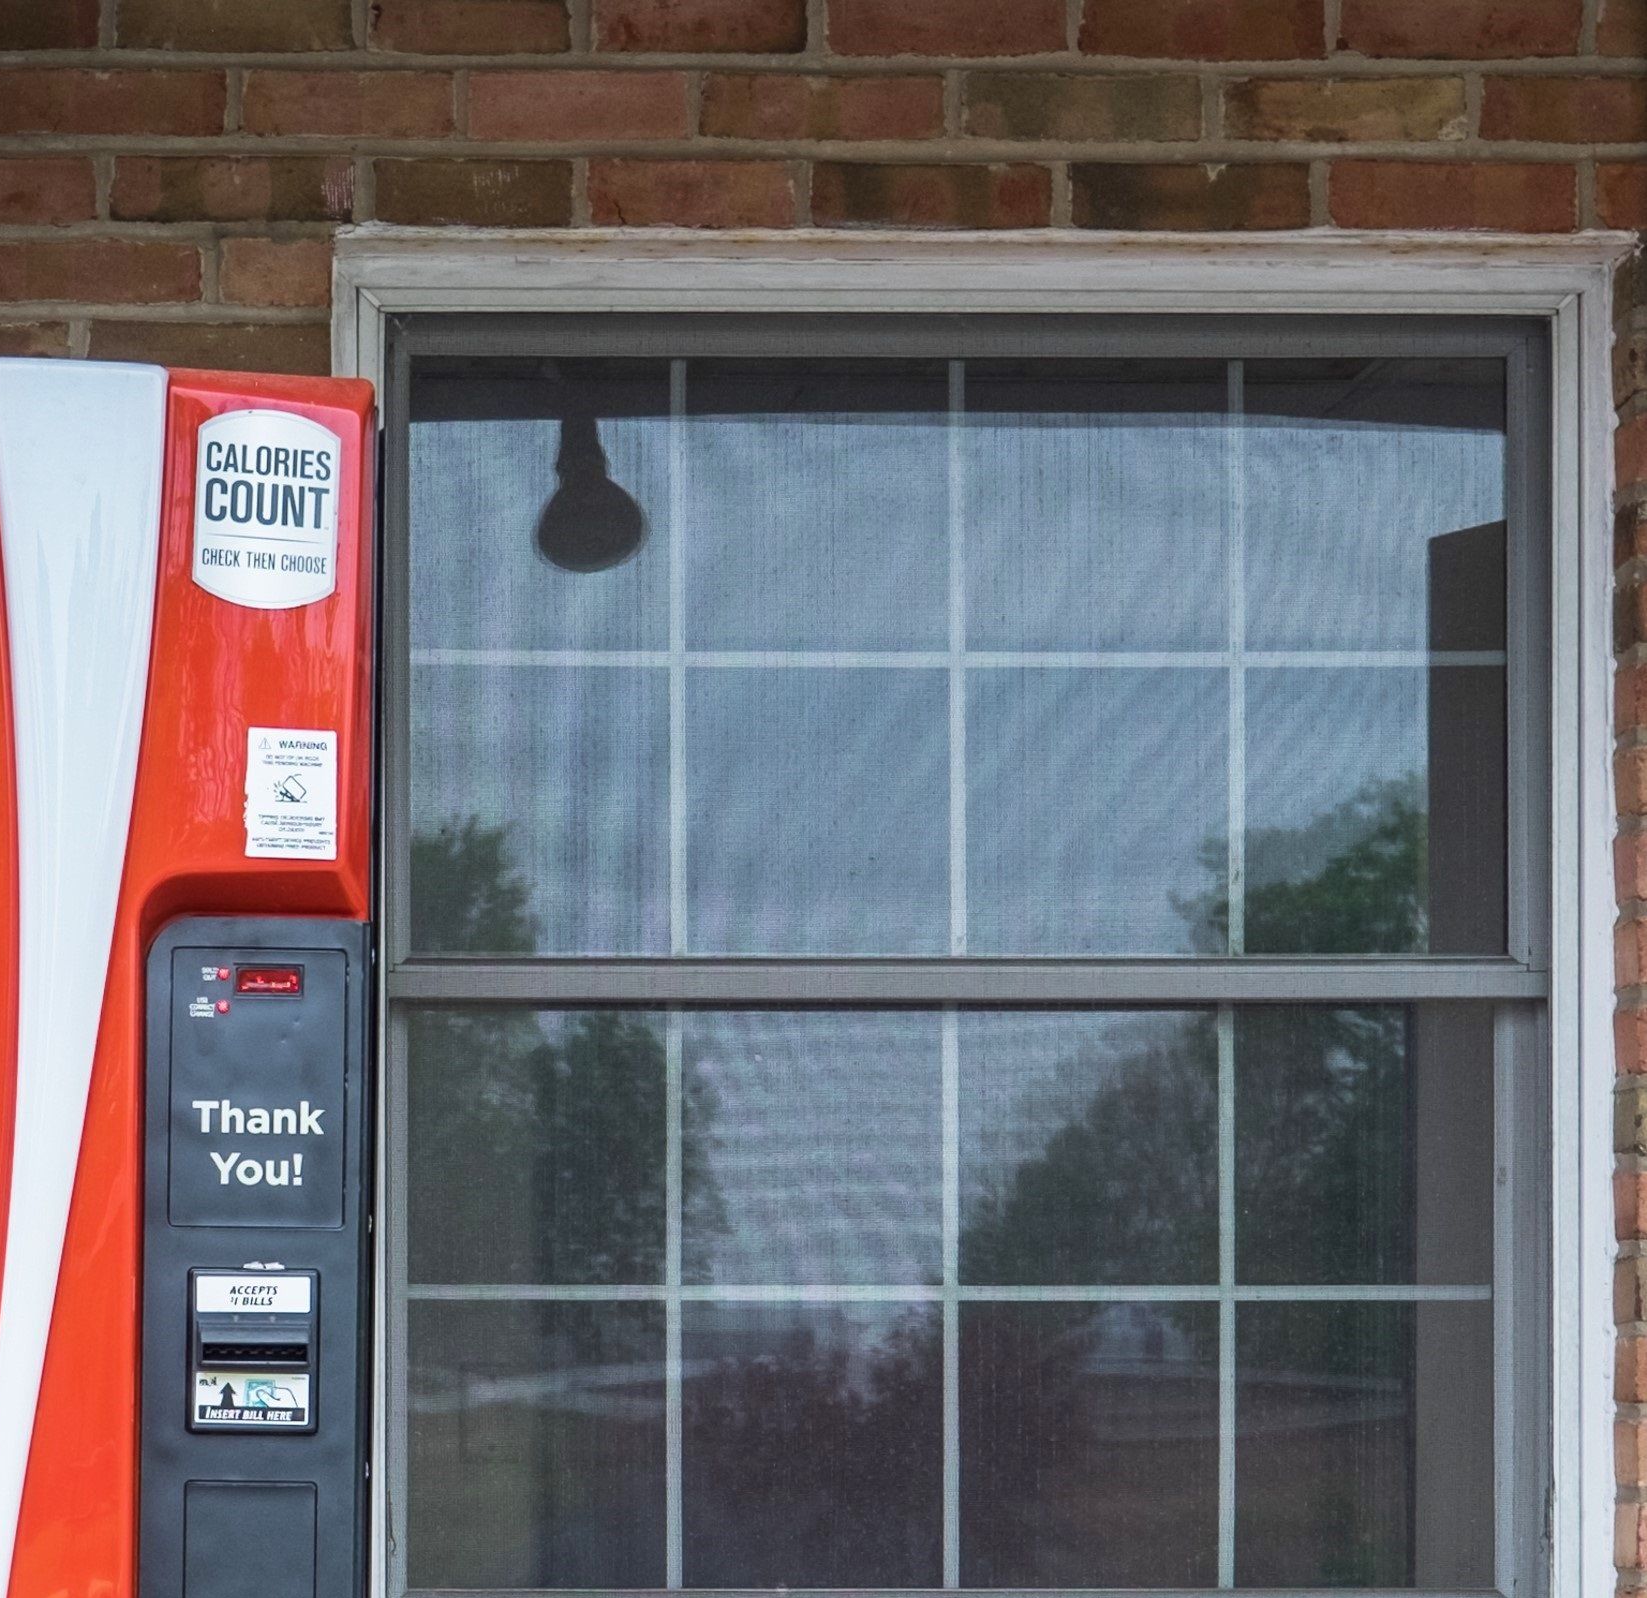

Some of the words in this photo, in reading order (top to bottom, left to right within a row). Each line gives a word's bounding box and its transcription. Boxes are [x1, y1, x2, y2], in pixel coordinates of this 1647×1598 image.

[206, 441, 331, 481] CALORIES
[205, 477, 329, 530] COUNT
[202, 547, 240, 567] CHECK
[246, 550, 276, 570] THEN
[281, 553, 327, 575] CHOOSE
[278, 740, 328, 751] WARNING
[192, 1099, 326, 1135] Thank
[210, 1152, 303, 1186] You!
[229, 1286, 278, 1295] ACCEPTS
[242, 1296, 272, 1306] BILLS
